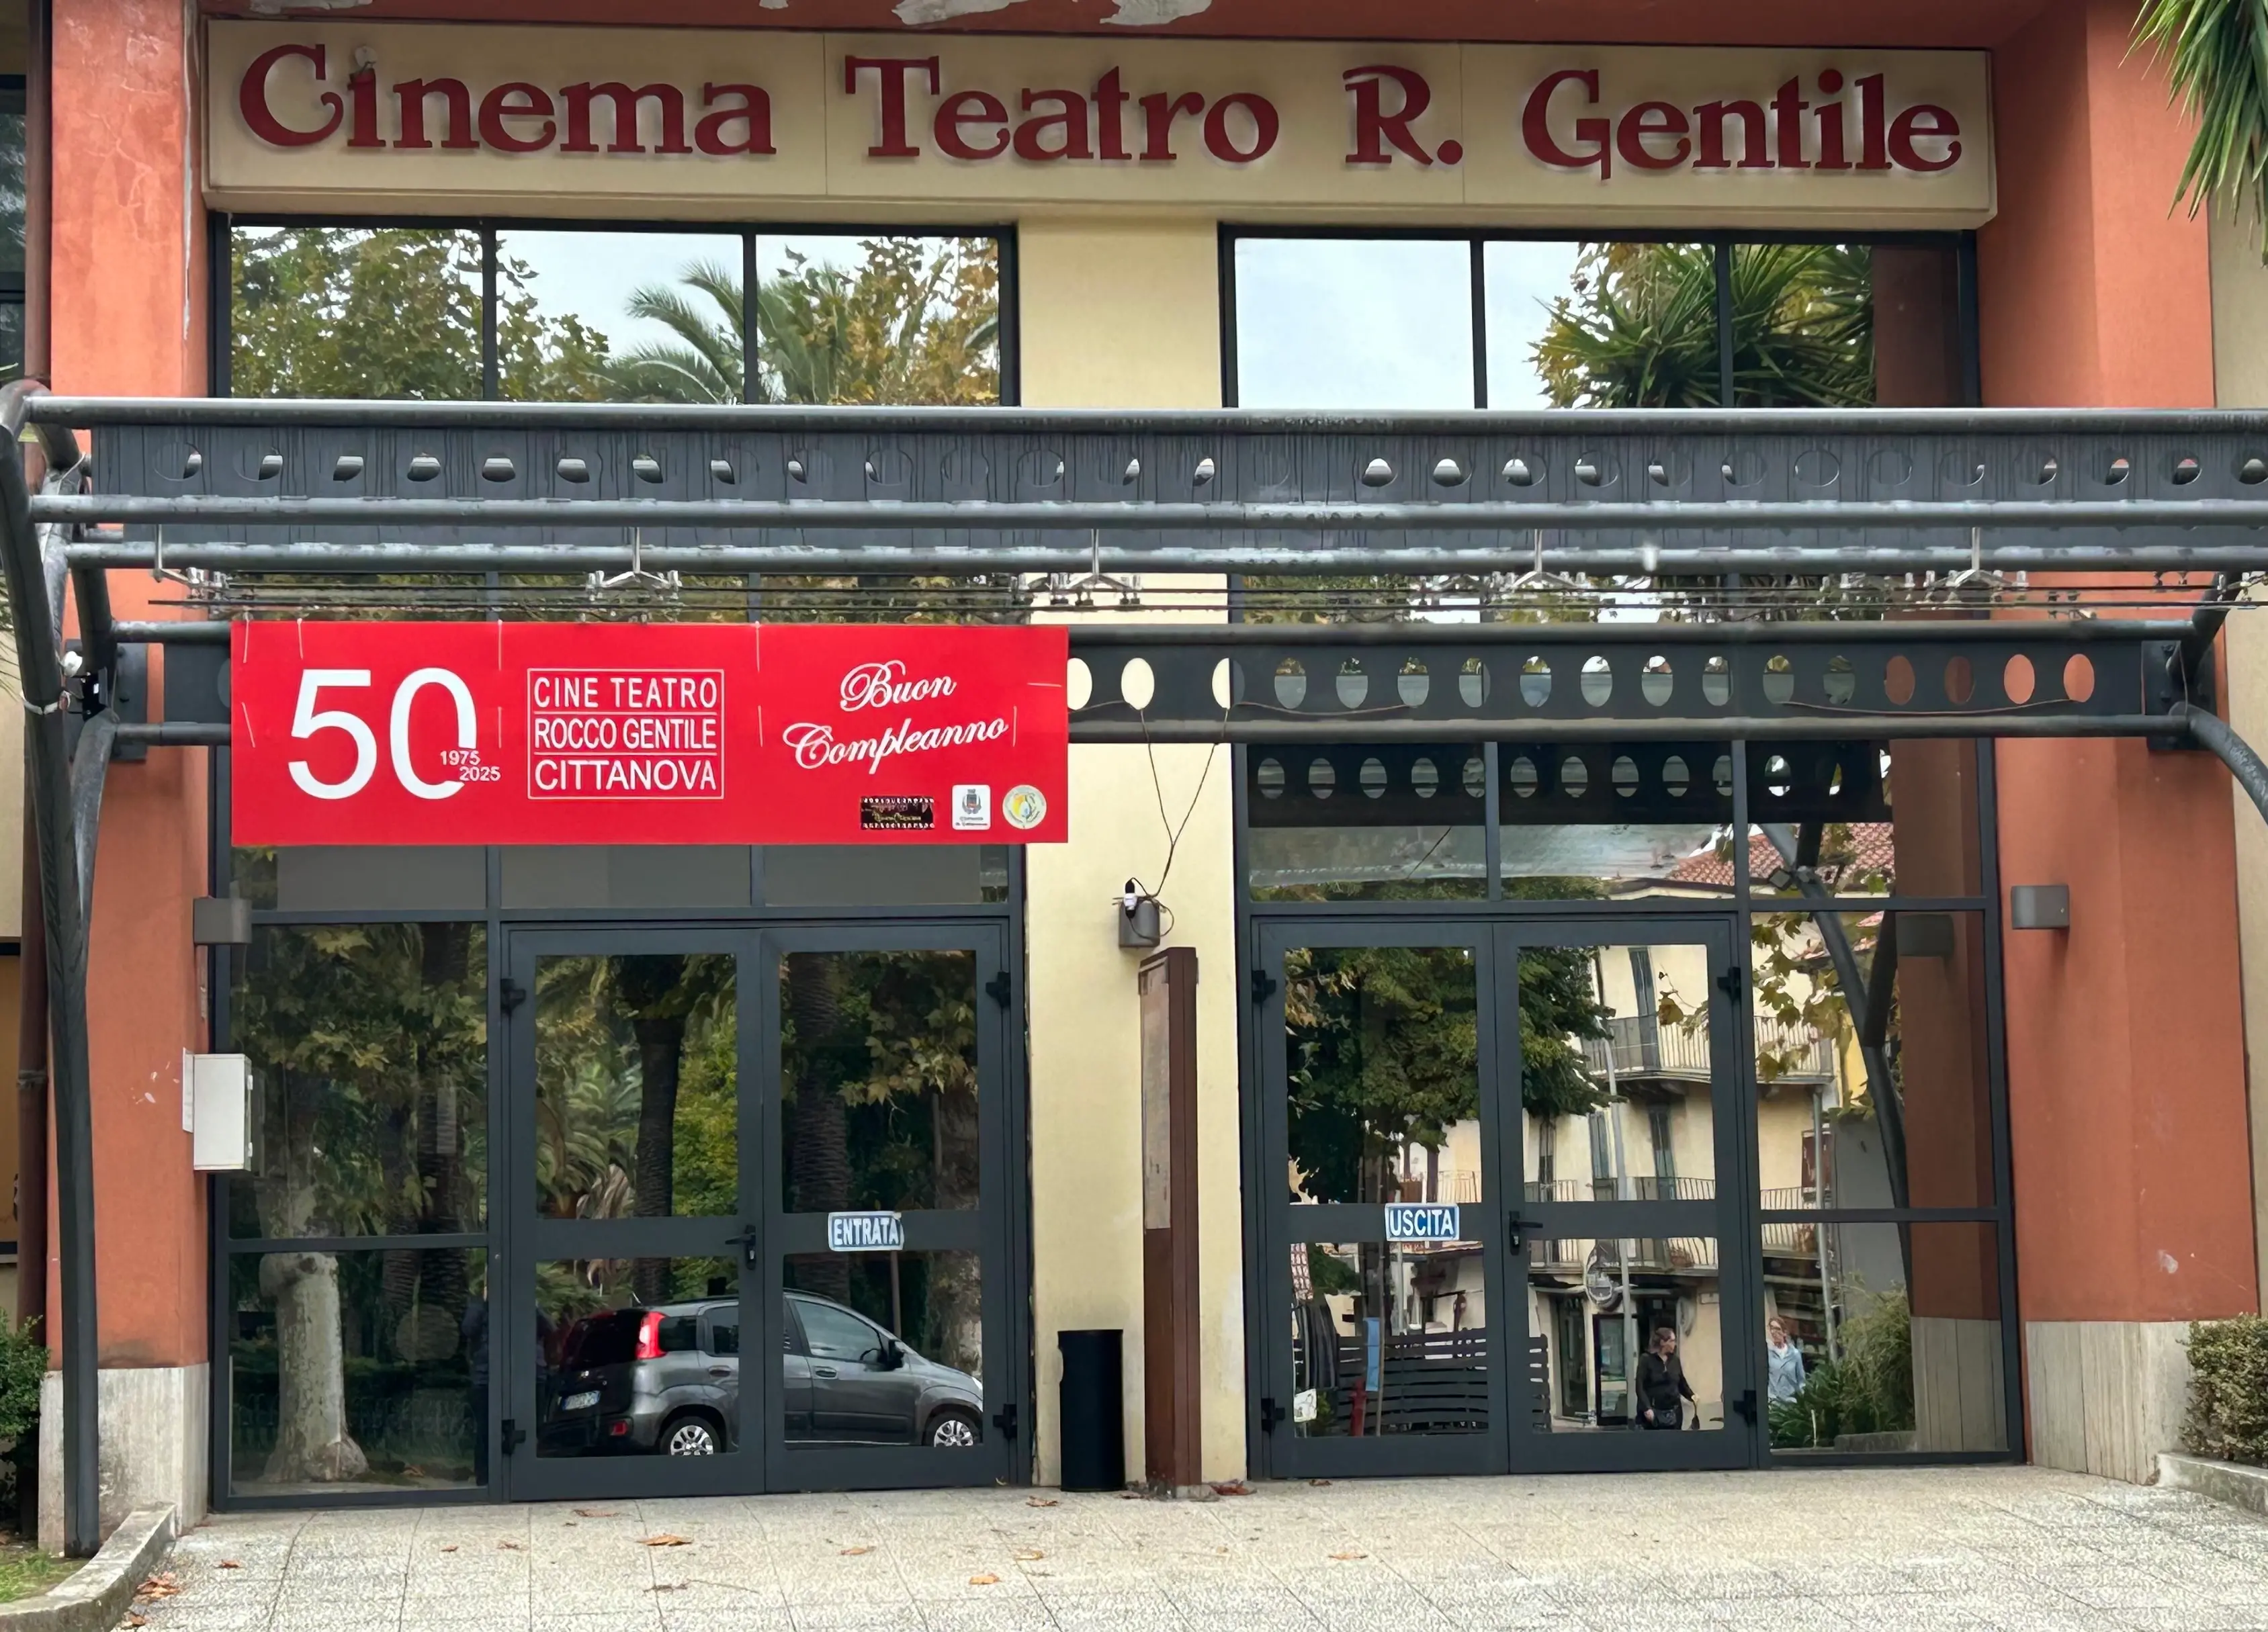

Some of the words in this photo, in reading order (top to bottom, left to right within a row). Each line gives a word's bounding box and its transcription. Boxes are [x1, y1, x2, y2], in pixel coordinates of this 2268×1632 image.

[238, 43, 777, 155] Cinema
[844, 55, 1280, 163] Teatro
[1342, 64, 1464, 166] R.
[1521, 68, 1963, 181] Gentile
[534, 677, 599, 708] CINE
[610, 677, 717, 709] TEATRO
[840, 660, 957, 712] Buon
[288, 667, 477, 800] 50
[535, 717, 617, 749] ROCCO
[623, 718, 717, 749] GENTILE
[783, 718, 1010, 774] Compleanno
[440, 750, 481, 766] 1975
[459, 766, 501, 782] 2025
[535, 759, 717, 790] CITTANOVA
[833, 1217, 900, 1245] ENTRATA
[1389, 1208, 1454, 1236] USCITA
